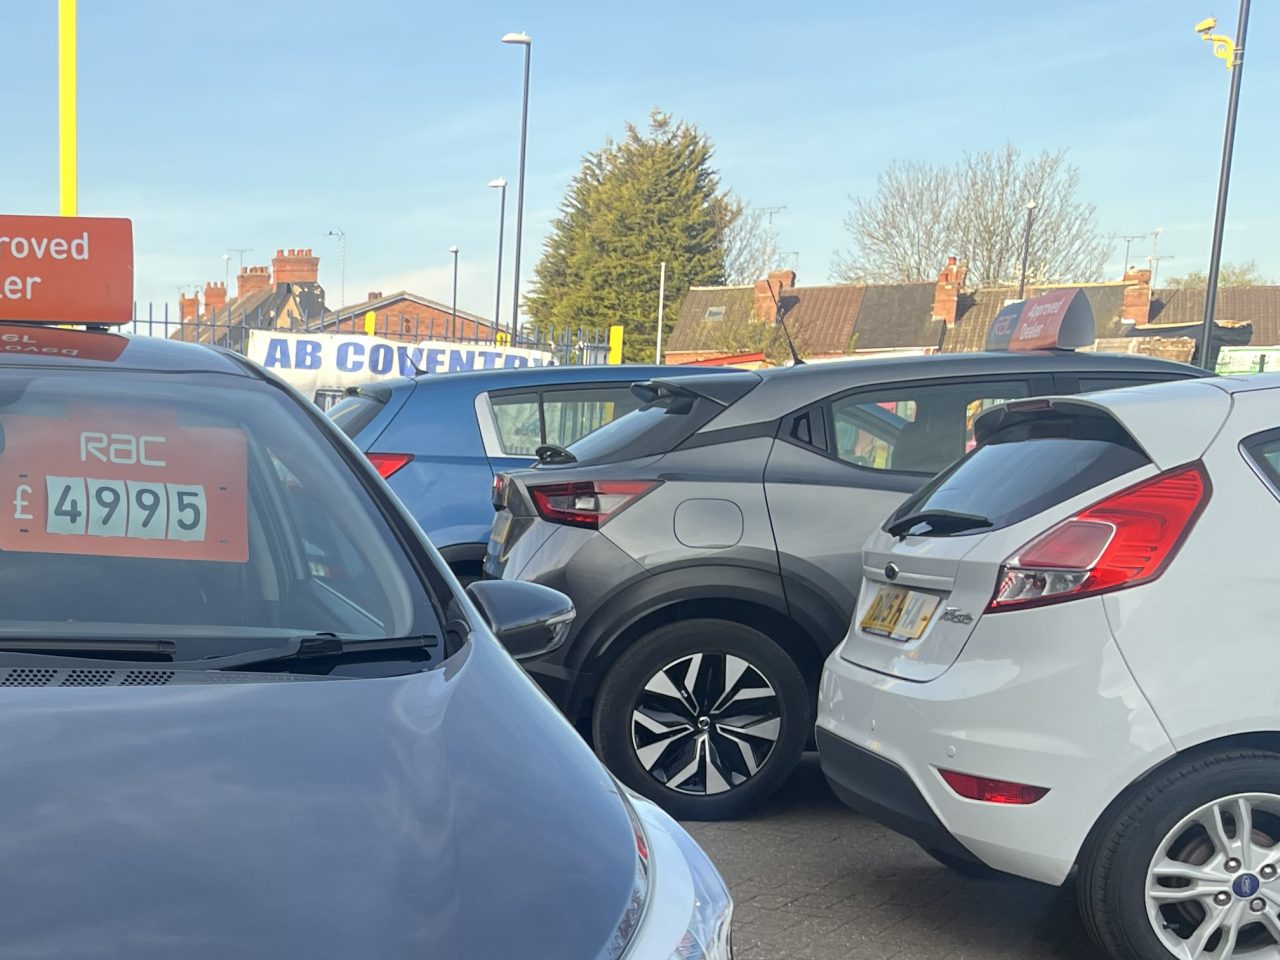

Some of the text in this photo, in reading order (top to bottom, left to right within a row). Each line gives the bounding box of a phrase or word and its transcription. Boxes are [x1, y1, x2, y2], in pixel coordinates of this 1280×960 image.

[1026, 299, 1066, 322] Approved
[1019, 322, 1045, 340] Dealer
[264, 338, 322, 369] AB
[13, 484, 201, 531] £ 4995
